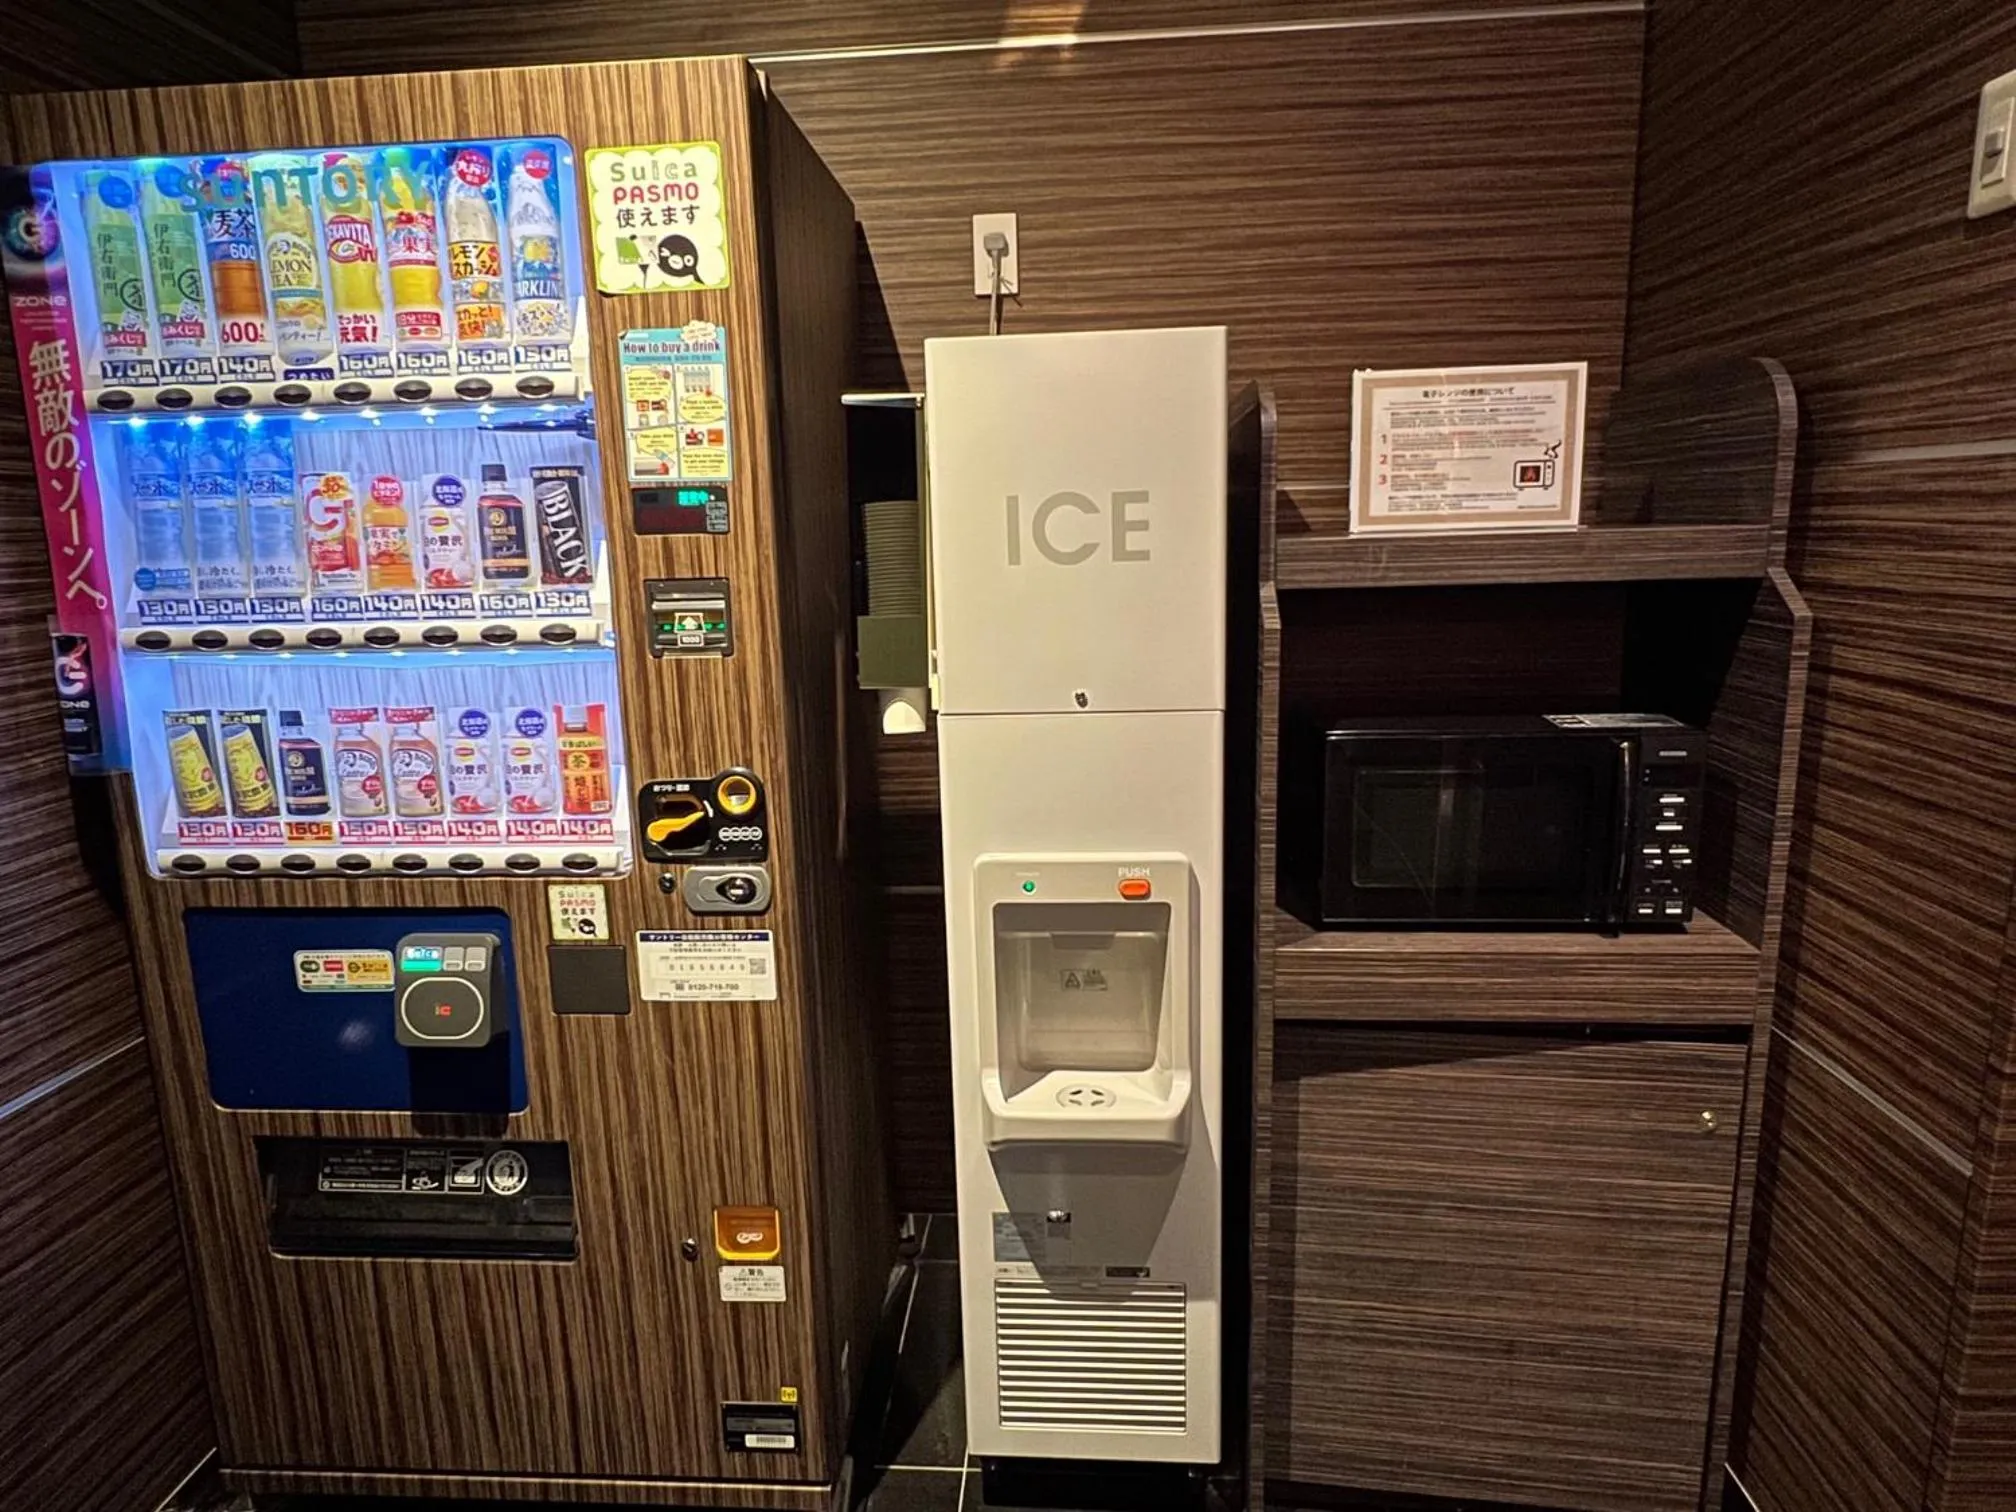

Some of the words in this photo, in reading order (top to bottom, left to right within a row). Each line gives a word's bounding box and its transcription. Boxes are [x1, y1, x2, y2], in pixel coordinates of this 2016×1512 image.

[610, 160, 698, 182] Suica
[612, 182, 700, 206] PASMO
[616, 204, 701, 229] 使えます
[624, 343, 648, 354] How
[649, 343, 660, 353] to
[661, 341, 682, 354] buy
[692, 339, 720, 352] drink
[541, 487, 592, 578] BLACK
[1006, 490, 1150, 566] ICE
[1118, 866, 1151, 878] PUSH
